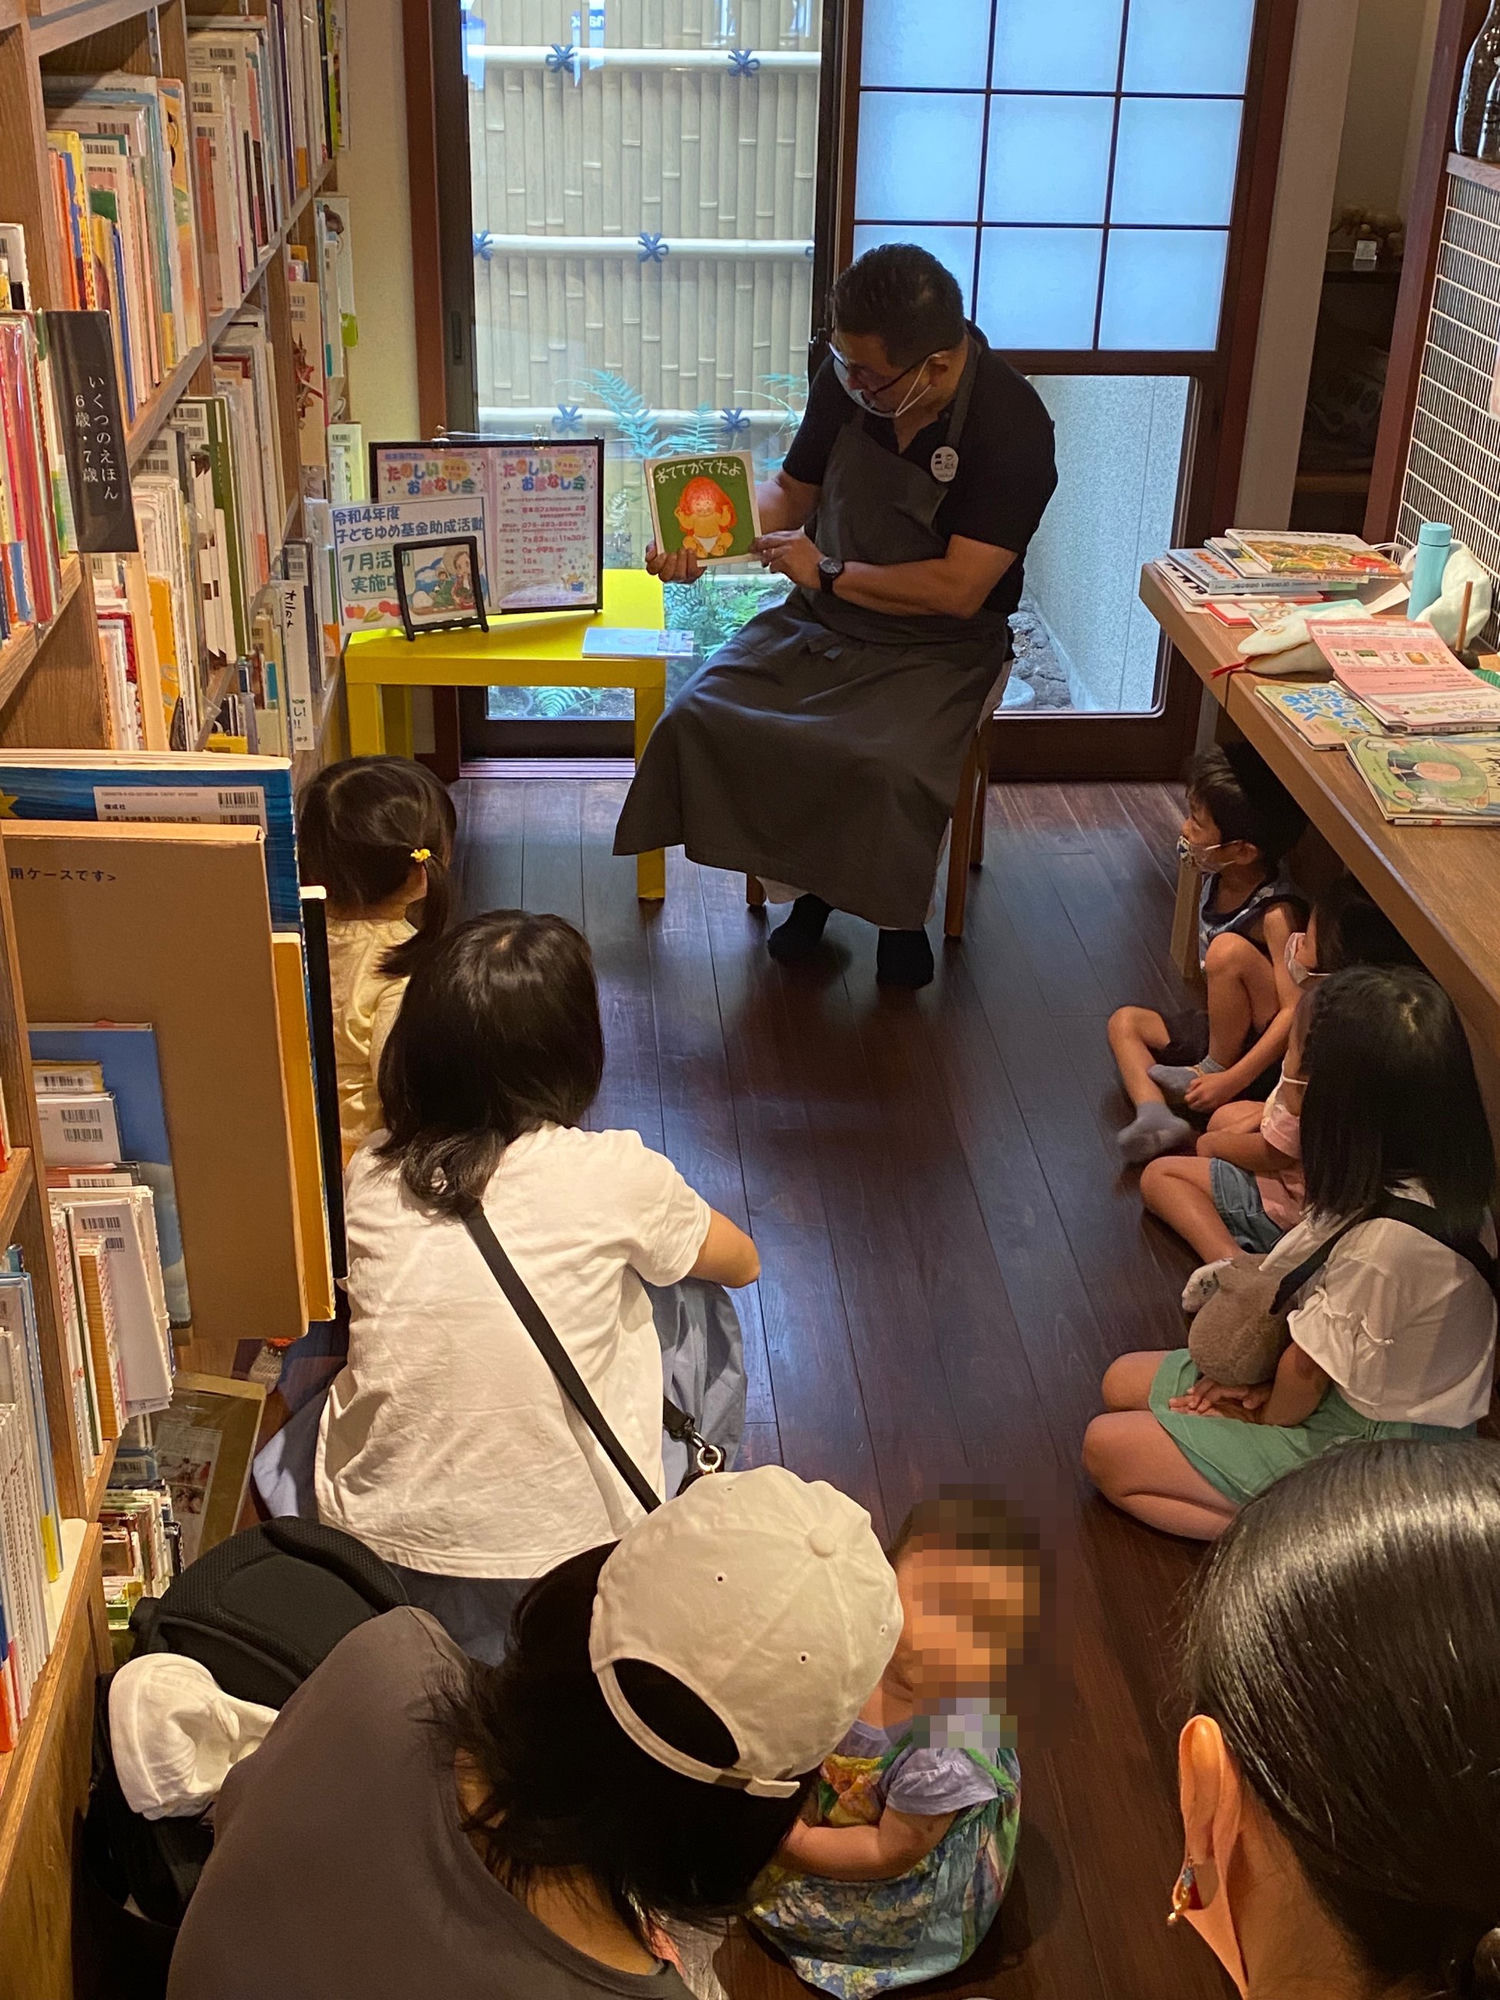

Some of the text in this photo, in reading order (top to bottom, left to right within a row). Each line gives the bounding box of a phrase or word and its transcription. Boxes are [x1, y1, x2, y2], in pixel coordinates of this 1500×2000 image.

[75, 394, 99, 483] 6歳・7歳
[88, 375, 119, 500] いくつのえほん
[387, 462, 439, 481] たのしい
[503, 458, 552, 478] たのしい
[407, 477, 476, 496] おはなし会
[521, 473, 586, 492] おはなし会
[334, 506, 400, 526] 令和4年度
[336, 516, 484, 544] 子どもゆめ基金助成活動
